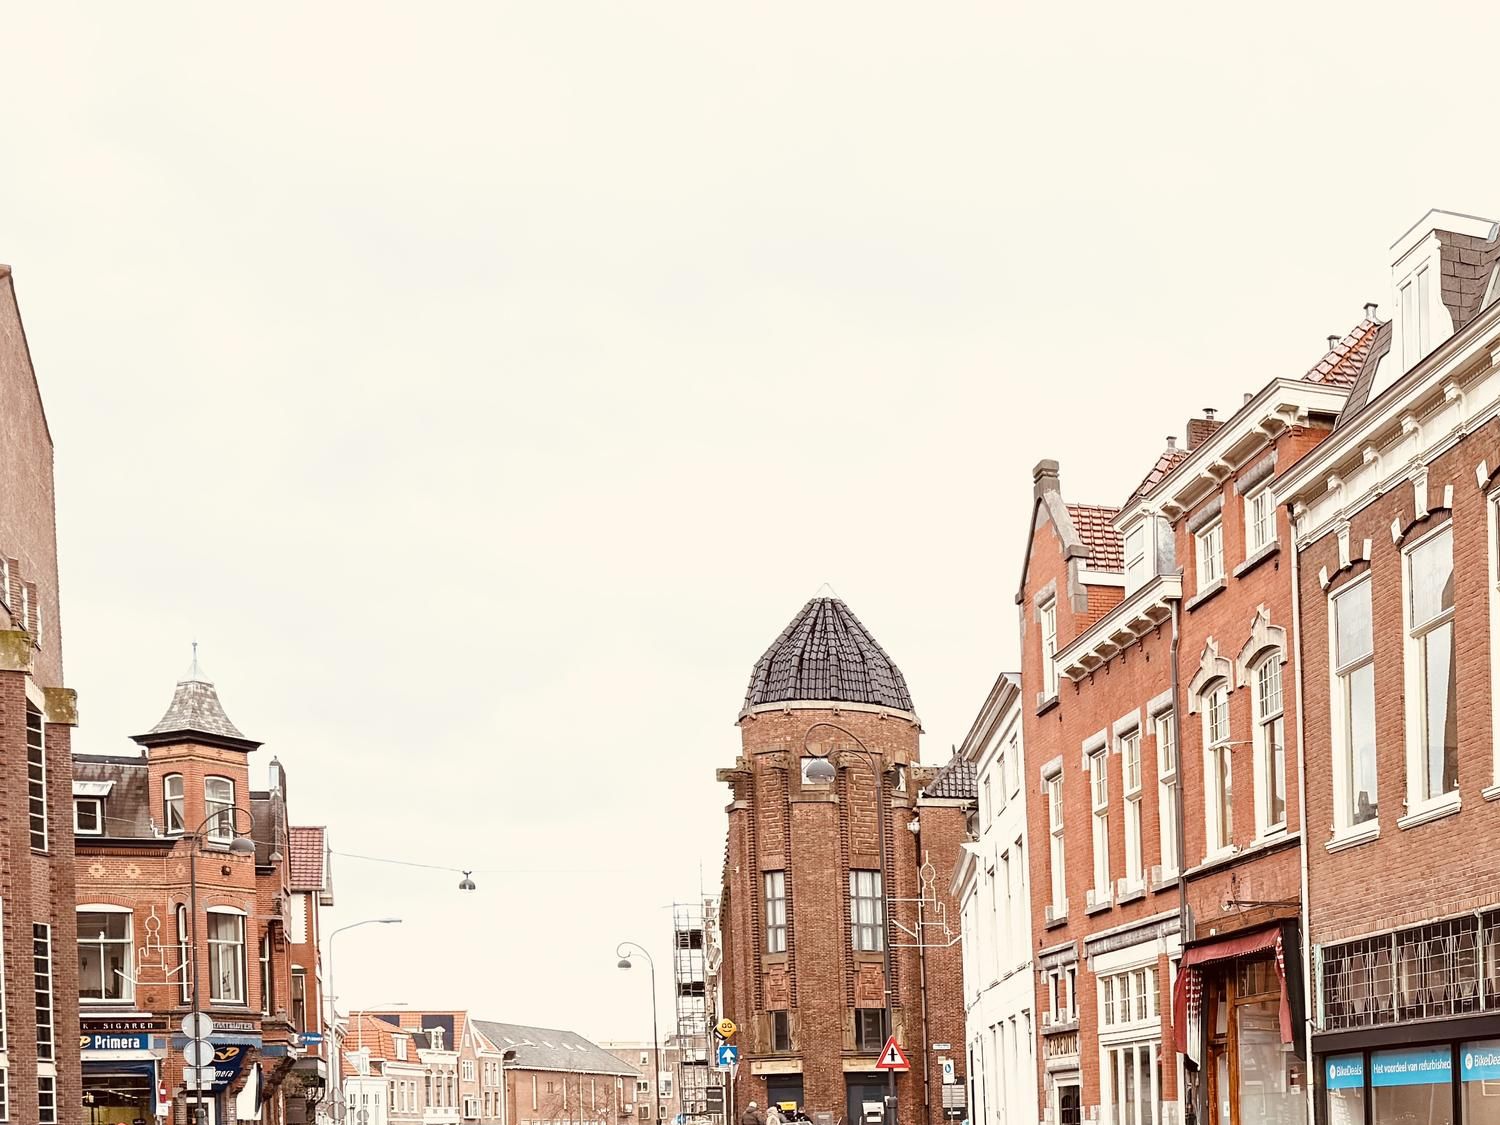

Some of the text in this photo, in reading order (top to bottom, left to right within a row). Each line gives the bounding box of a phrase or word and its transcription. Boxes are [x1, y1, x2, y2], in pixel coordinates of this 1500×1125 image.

[95, 1035, 140, 1049] Primera
[1336, 1064, 1362, 1077] BikeDeals
[1373, 1058, 1451, 1074] Het voordeel van refurbished
[215, 1070, 234, 1078] mera
